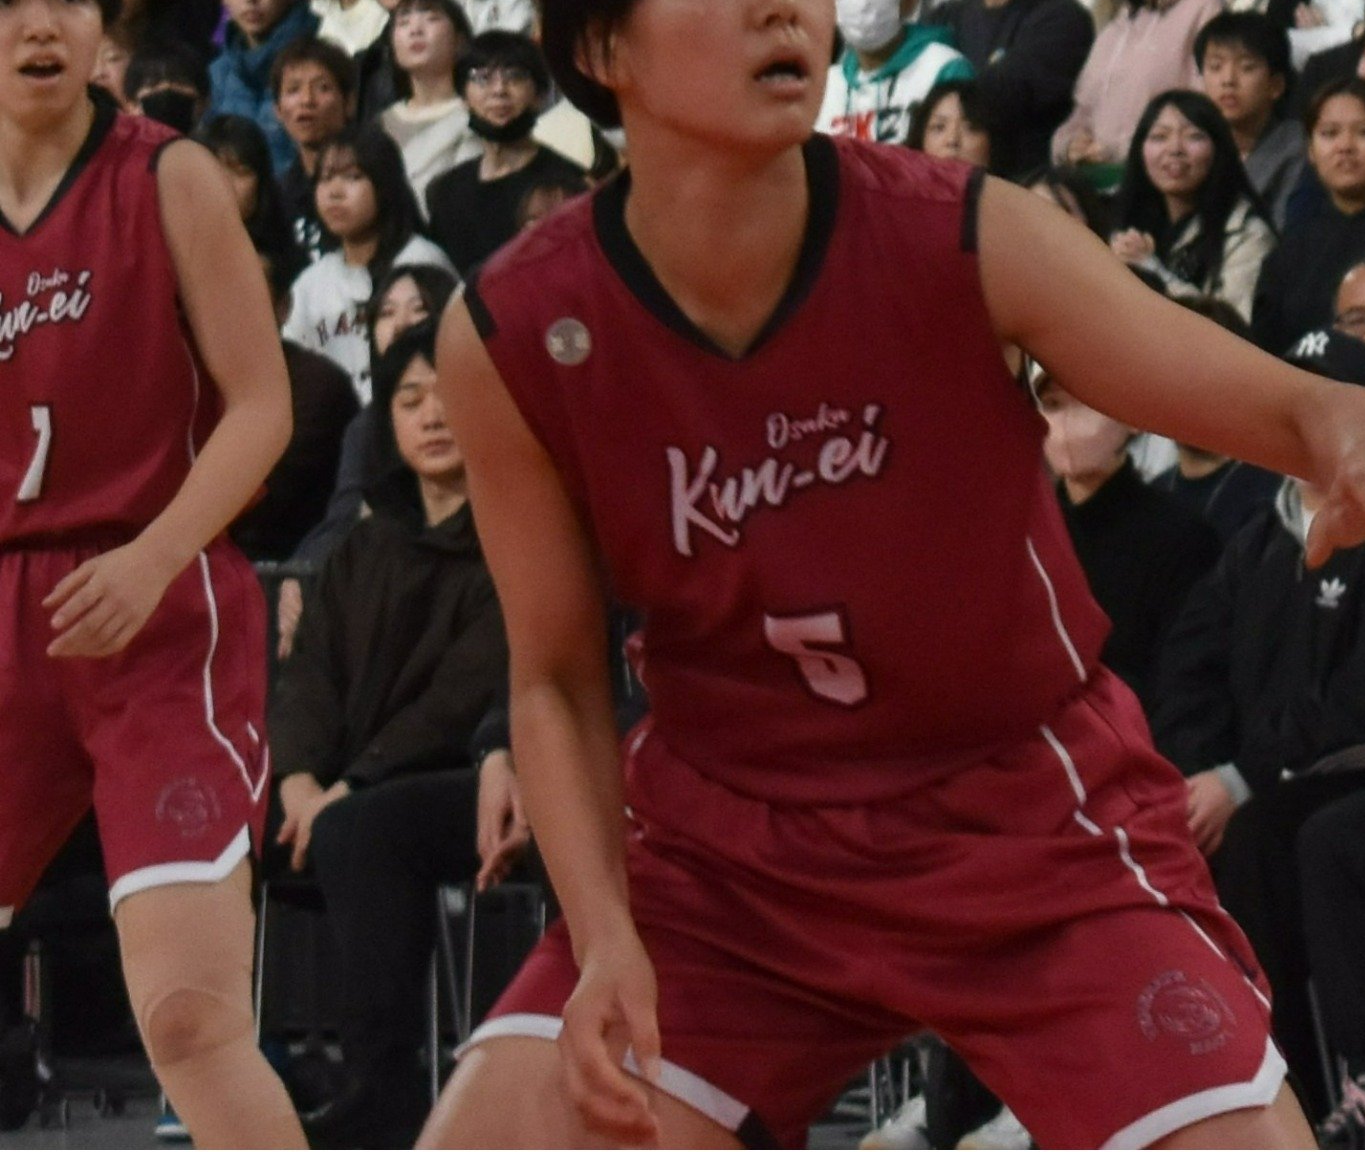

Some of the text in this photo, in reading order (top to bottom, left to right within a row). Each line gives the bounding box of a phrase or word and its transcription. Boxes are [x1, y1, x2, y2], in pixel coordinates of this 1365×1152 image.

[0, 270, 91, 360] un-ei
[766, 403, 850, 449] Osaka
[764, 611, 867, 705] 5
